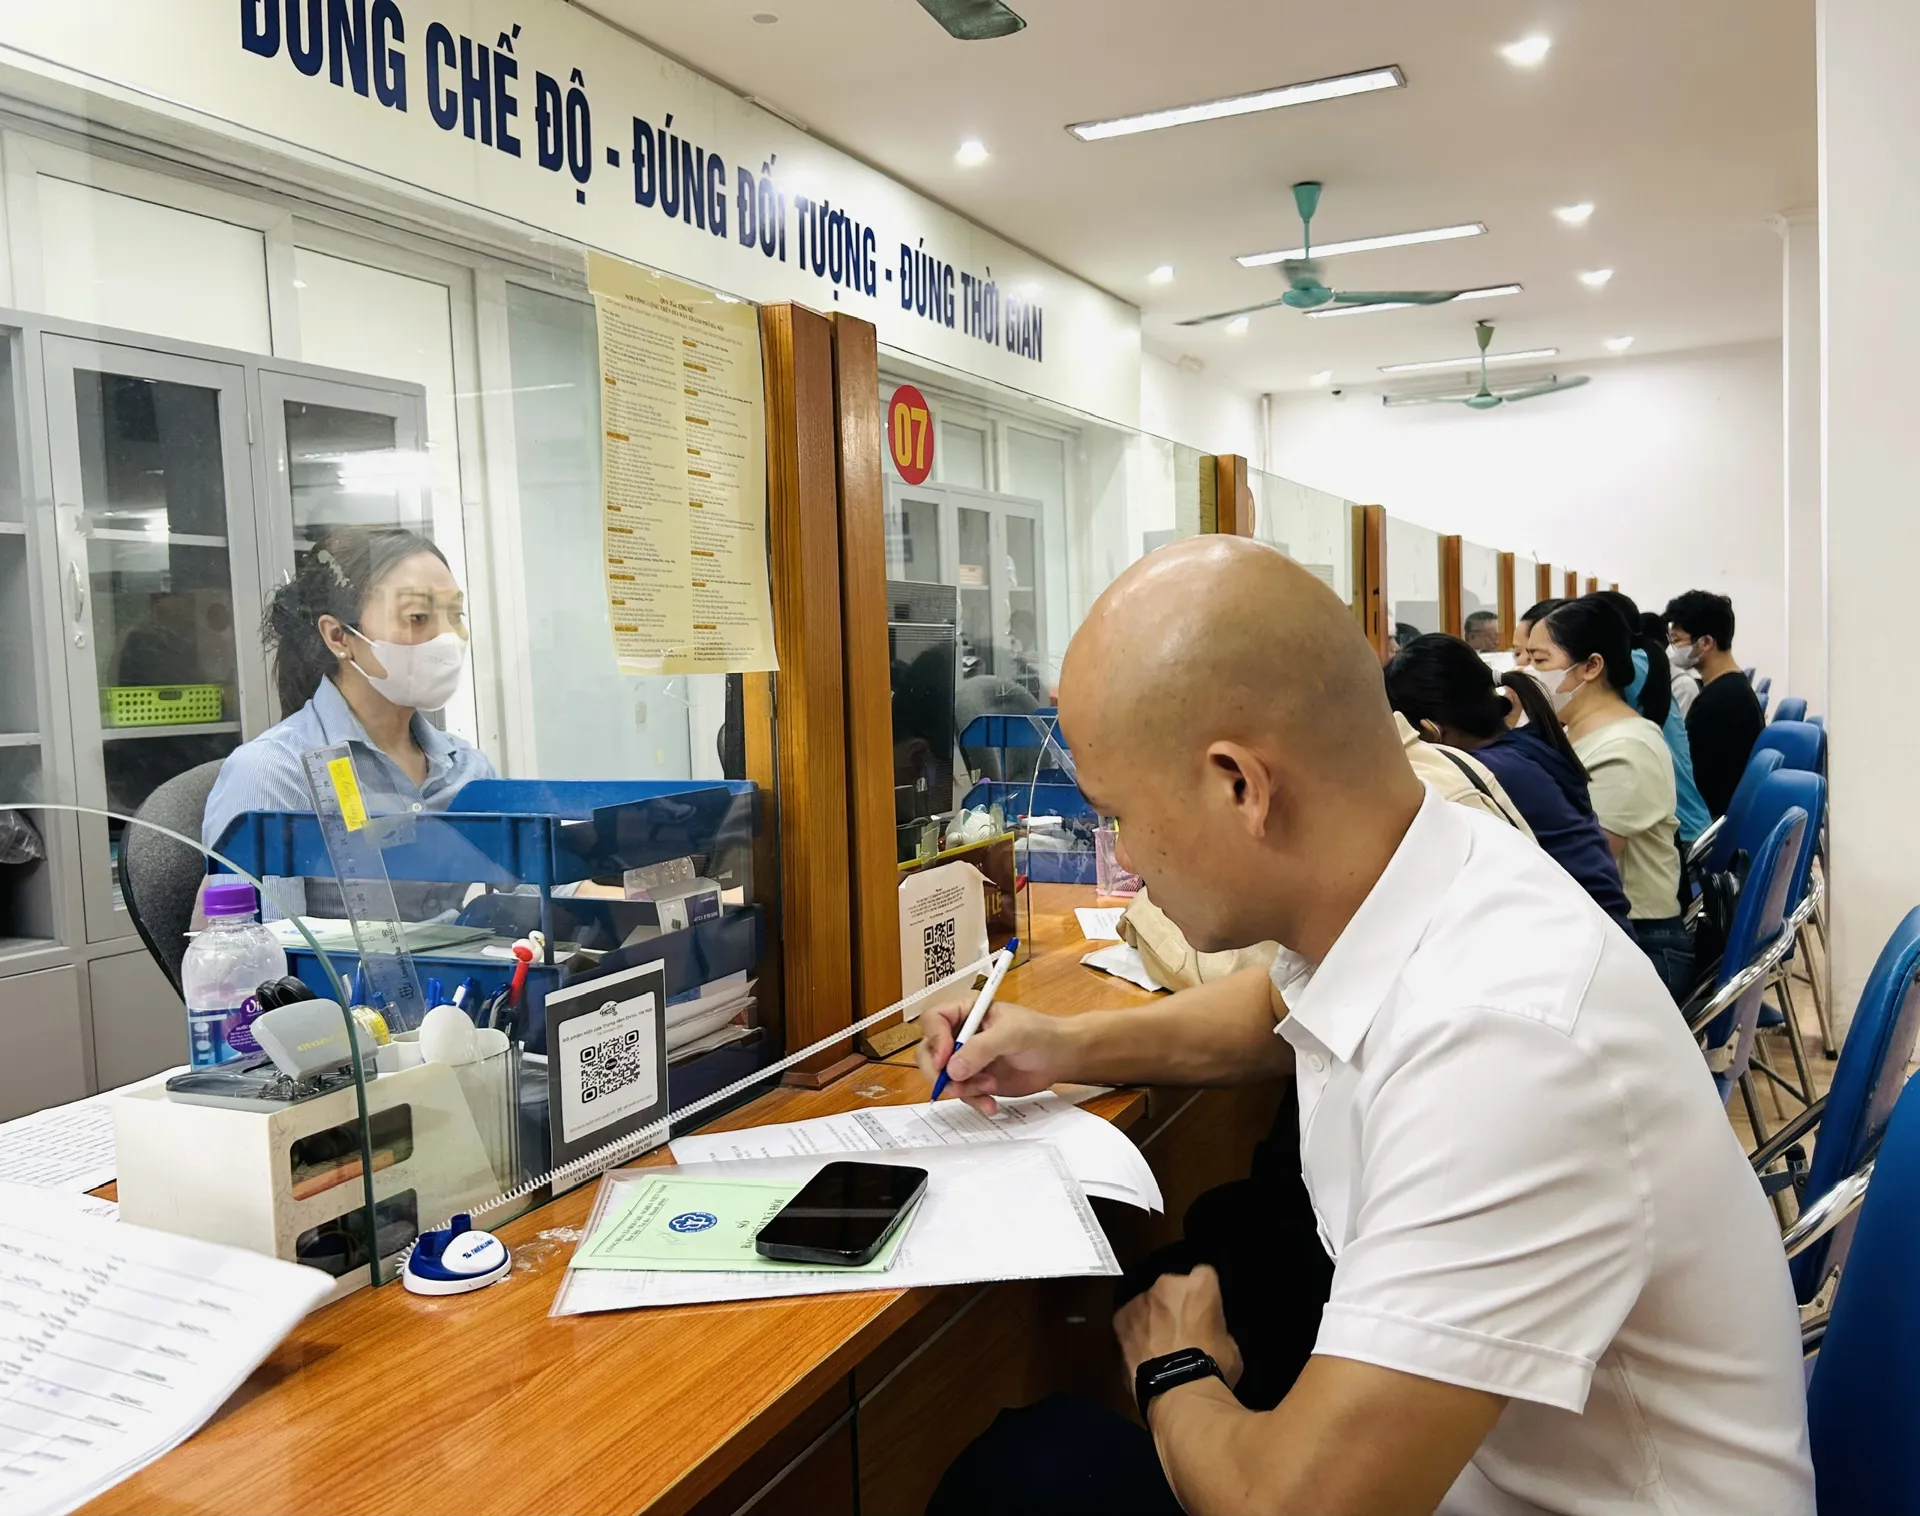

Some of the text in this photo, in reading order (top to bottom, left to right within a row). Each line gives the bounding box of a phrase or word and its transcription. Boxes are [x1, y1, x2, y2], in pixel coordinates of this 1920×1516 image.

[426, 23, 522, 158] CHẾ
[535, 67, 593, 205] ĐỘ
[632, 112, 727, 238] ĐÚNG
[736, 153, 786, 262] ĐỐI
[794, 194, 877, 301] TƯỢNG
[900, 237, 955, 330] ĐÚNG
[960, 265, 1000, 347] THỜI
[1005, 292, 1043, 364] GIAN
[894, 402, 928, 470] 07
